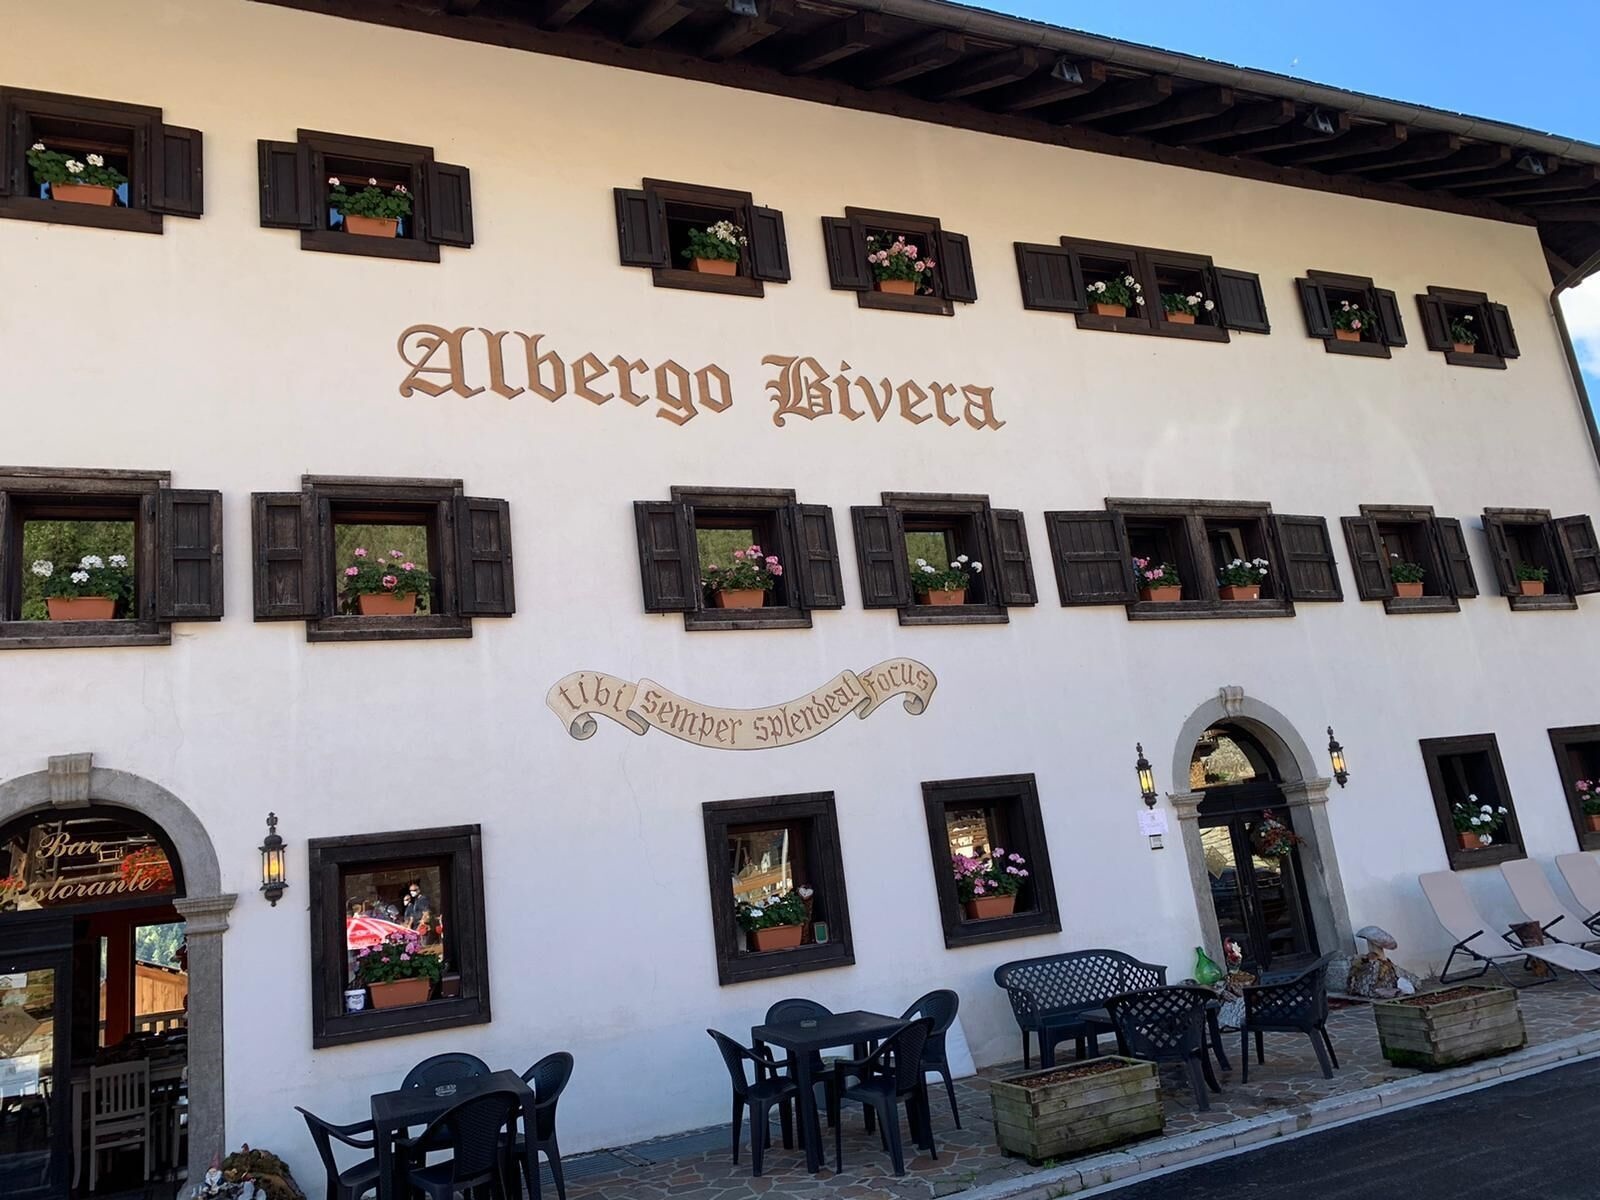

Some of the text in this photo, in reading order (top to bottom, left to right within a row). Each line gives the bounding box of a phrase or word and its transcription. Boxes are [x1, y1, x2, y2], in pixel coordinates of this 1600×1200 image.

[398, 324, 1006, 431] Albergo Bivera
[559, 674, 628, 712] tibi
[640, 690, 743, 744] semper
[35, 832, 102, 859] Bar
